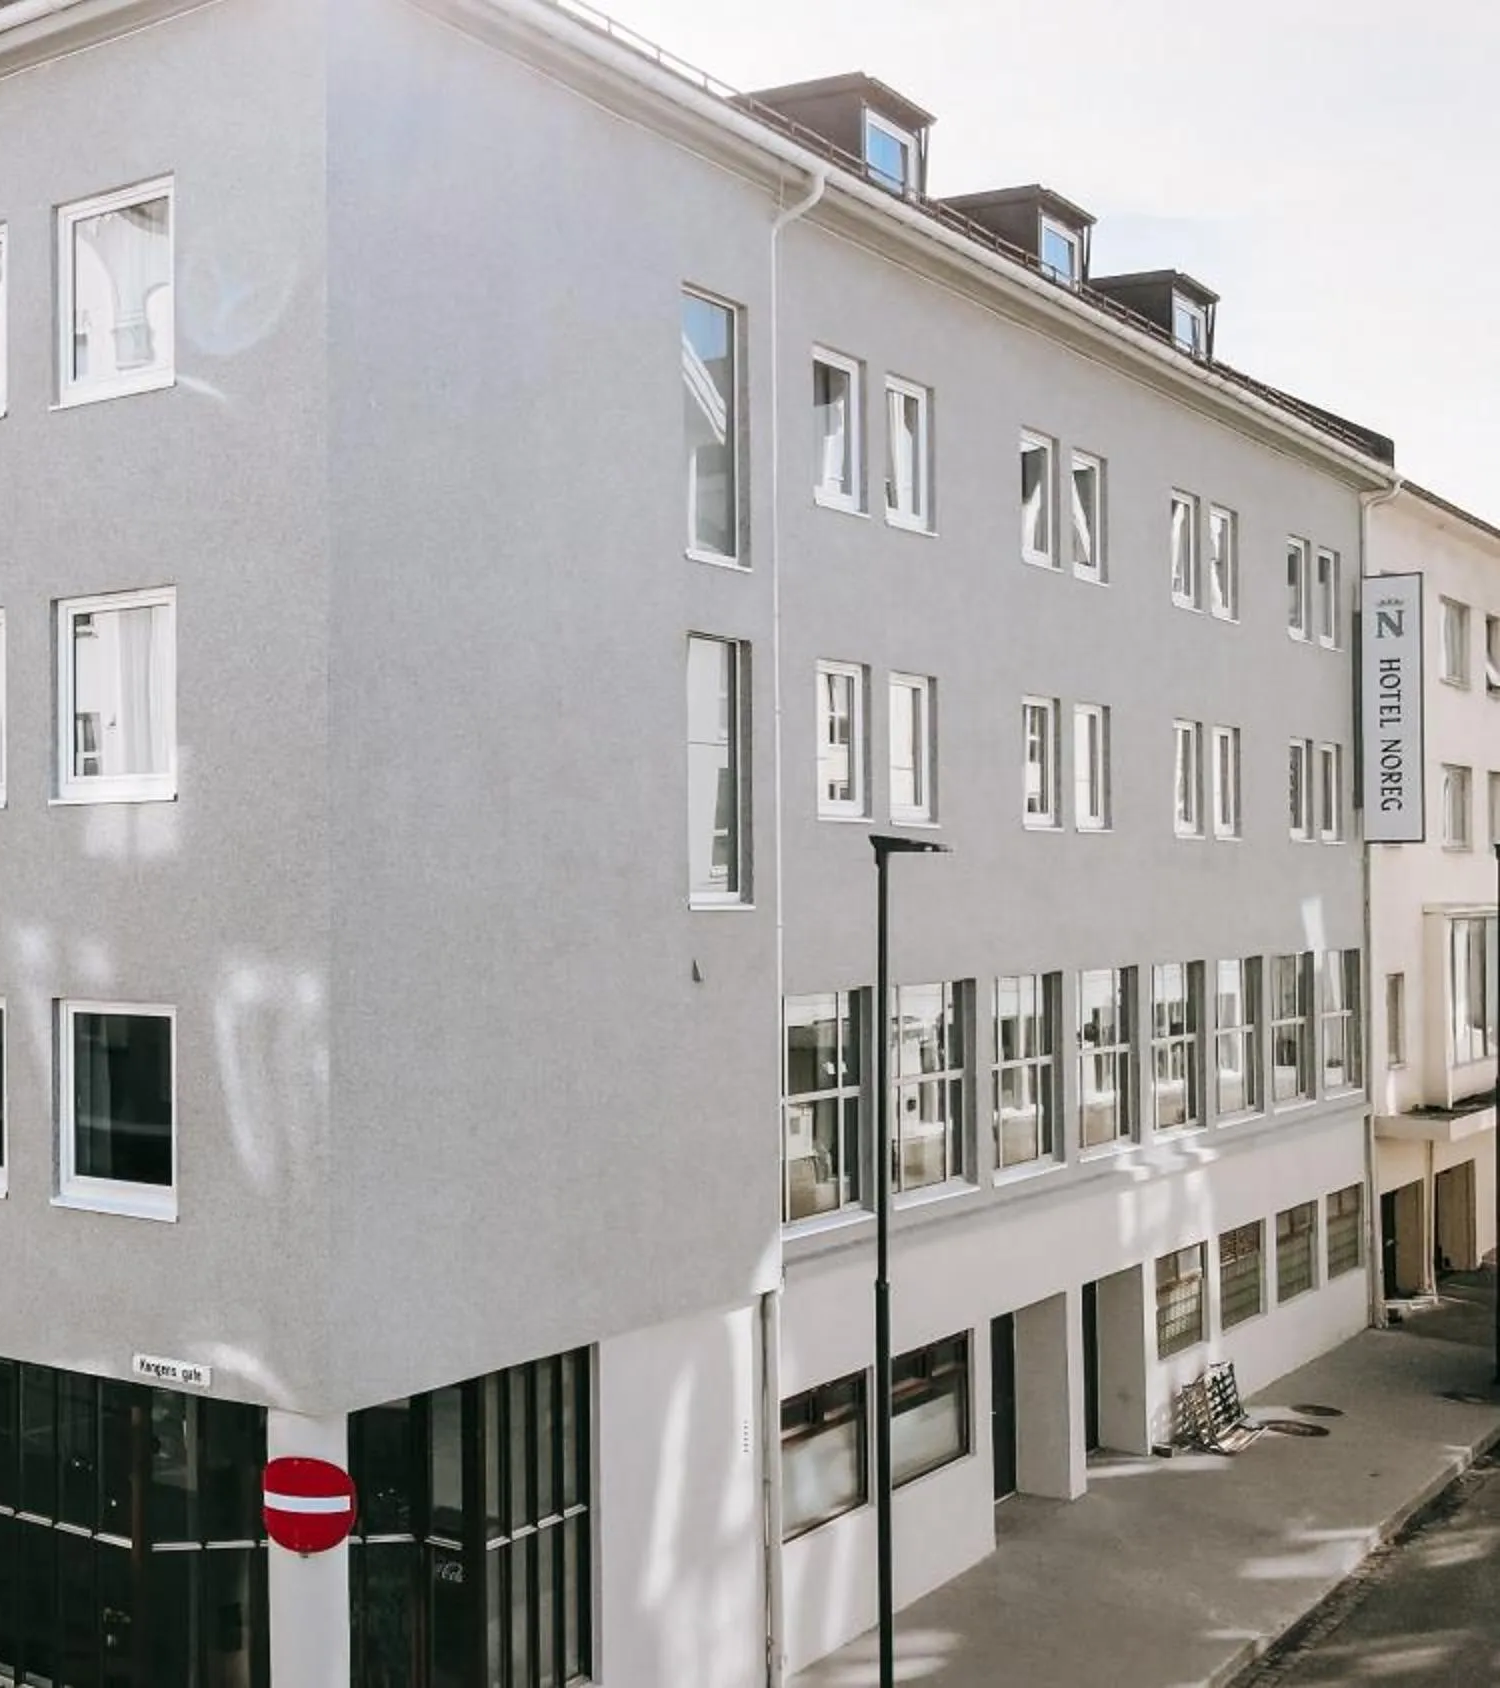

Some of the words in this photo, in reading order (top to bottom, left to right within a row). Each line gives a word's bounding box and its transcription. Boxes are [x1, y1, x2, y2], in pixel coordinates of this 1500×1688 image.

[1375, 609, 1405, 639] N
[1379, 658, 1401, 729] HOTEL
[1380, 739, 1403, 812] NOREG
